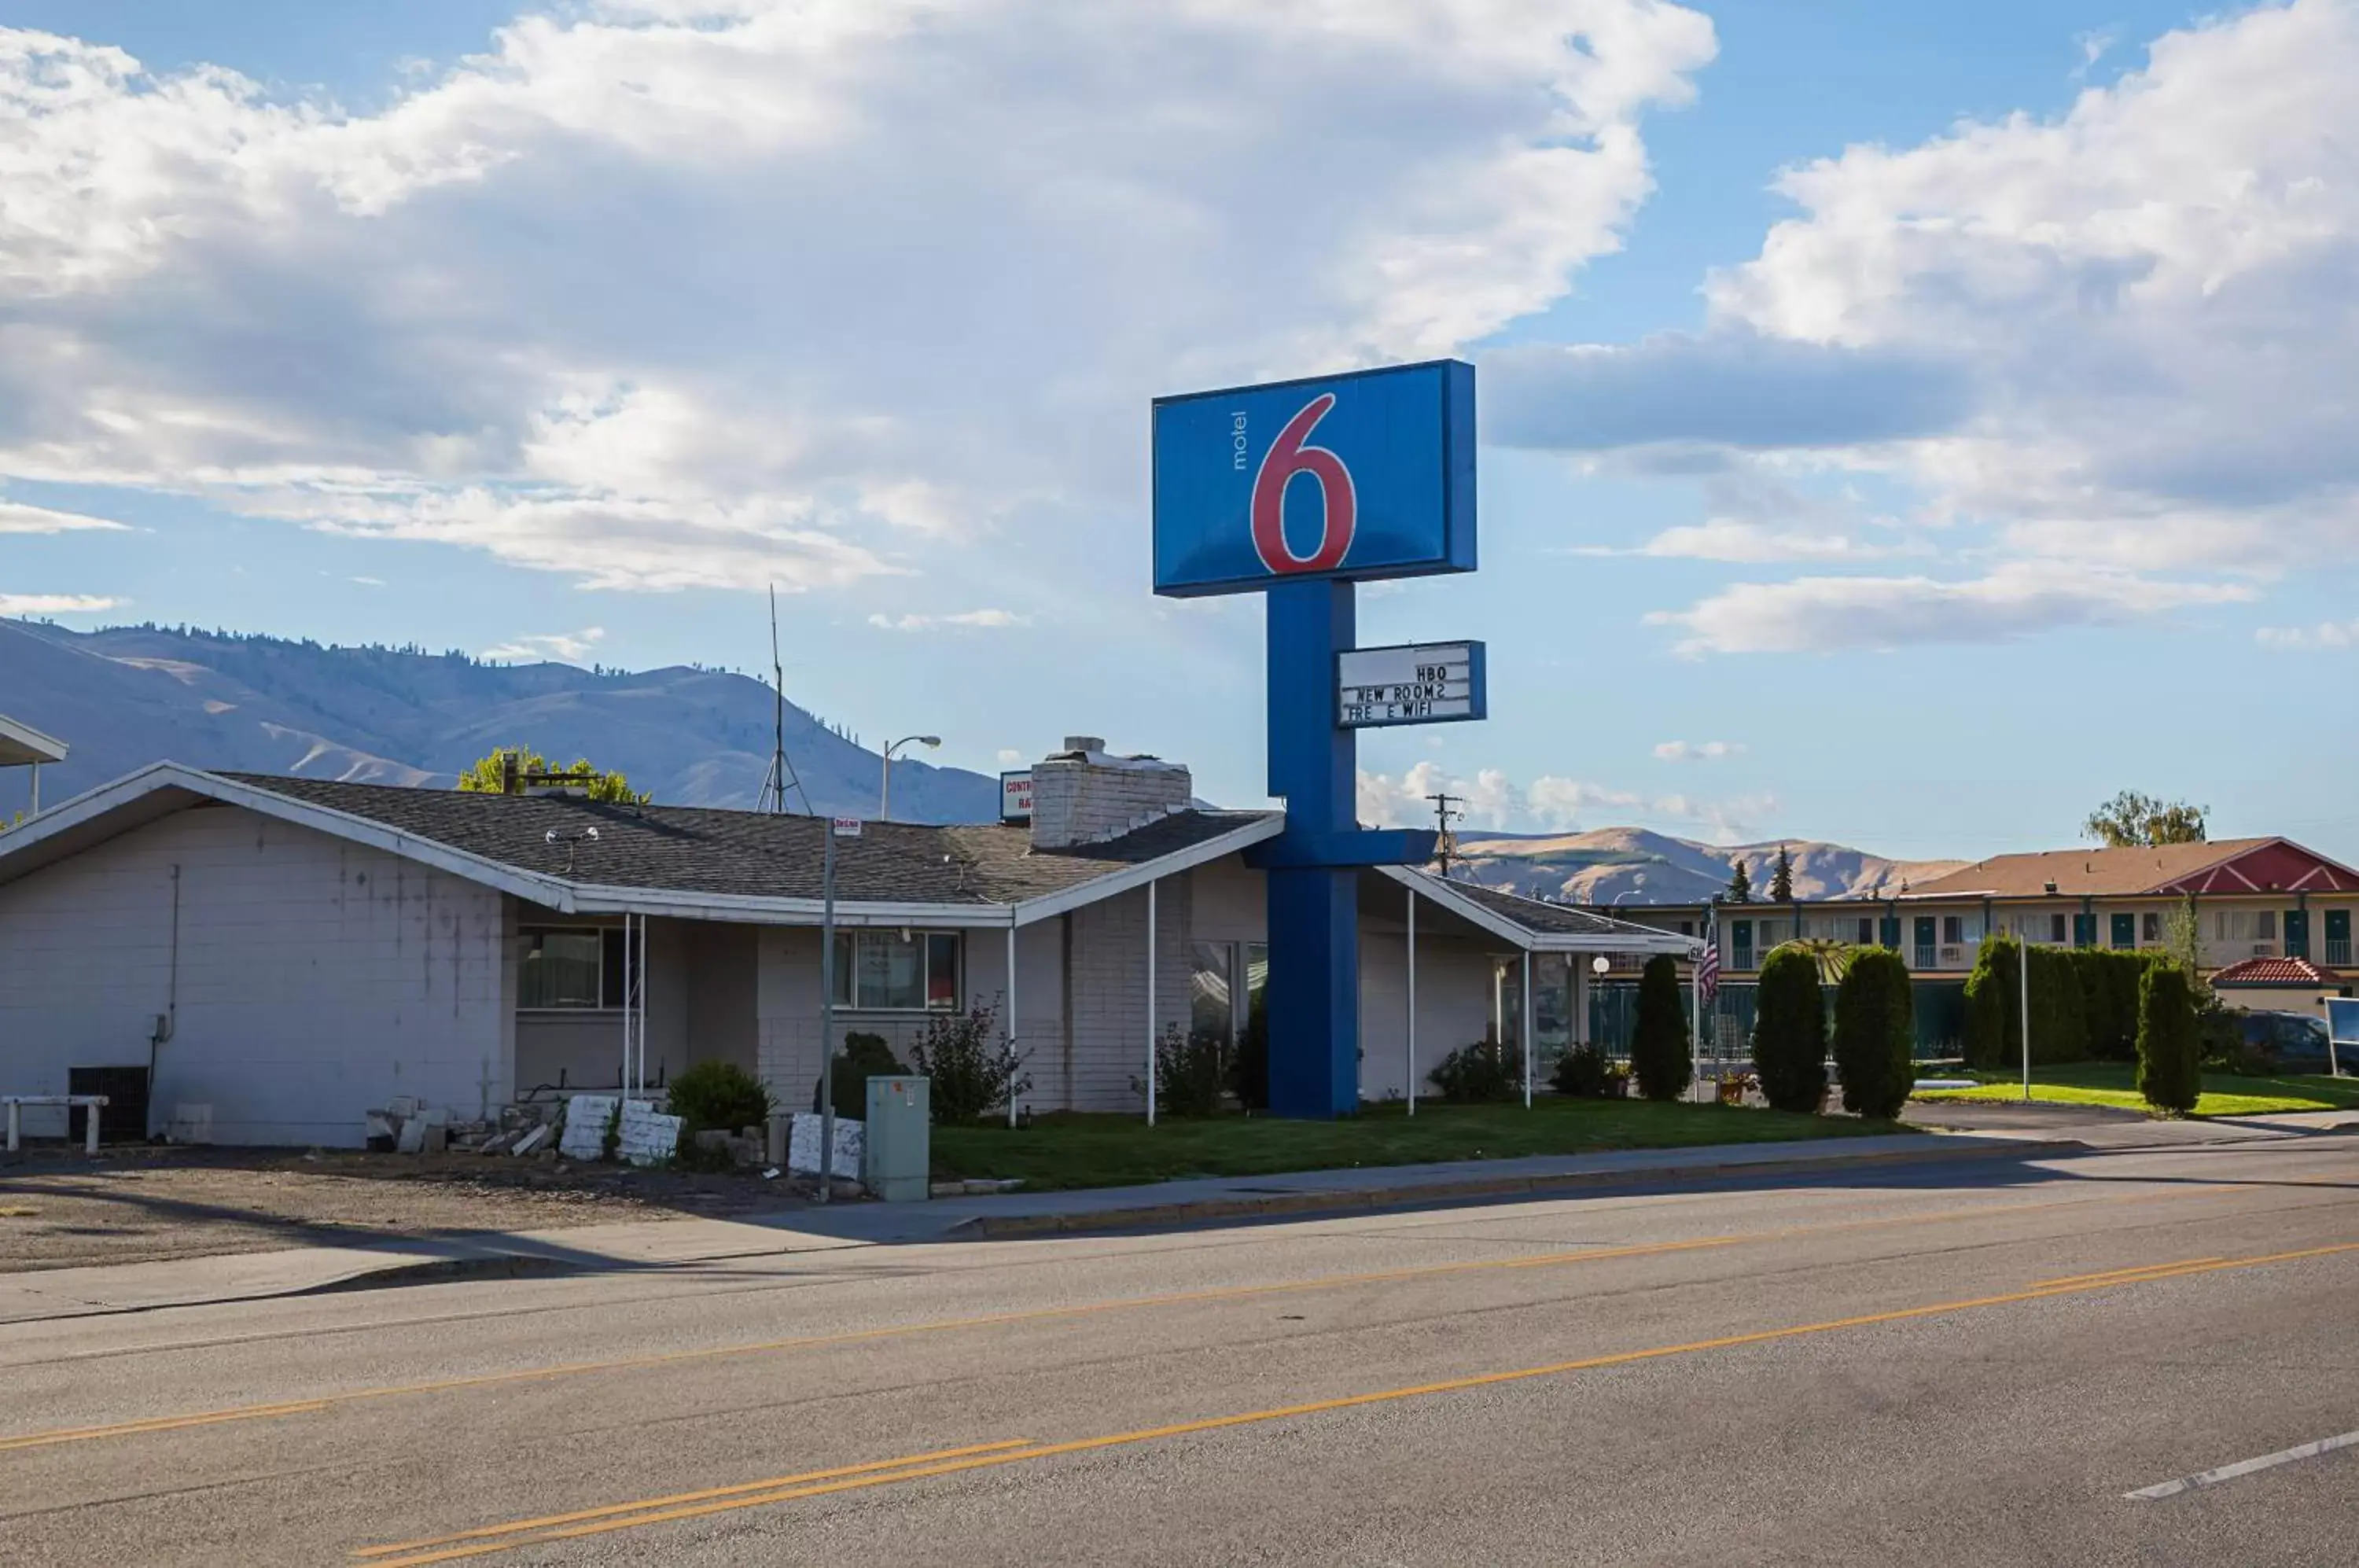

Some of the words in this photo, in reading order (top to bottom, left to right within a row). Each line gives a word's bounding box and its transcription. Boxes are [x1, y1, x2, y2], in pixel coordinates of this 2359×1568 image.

[1231, 410, 1246, 470] motel
[1250, 392, 1357, 575] 6
[1417, 666, 1447, 682] HBO
[1356, 687, 1384, 703] NEW
[1402, 701, 1431, 717] WIFI
